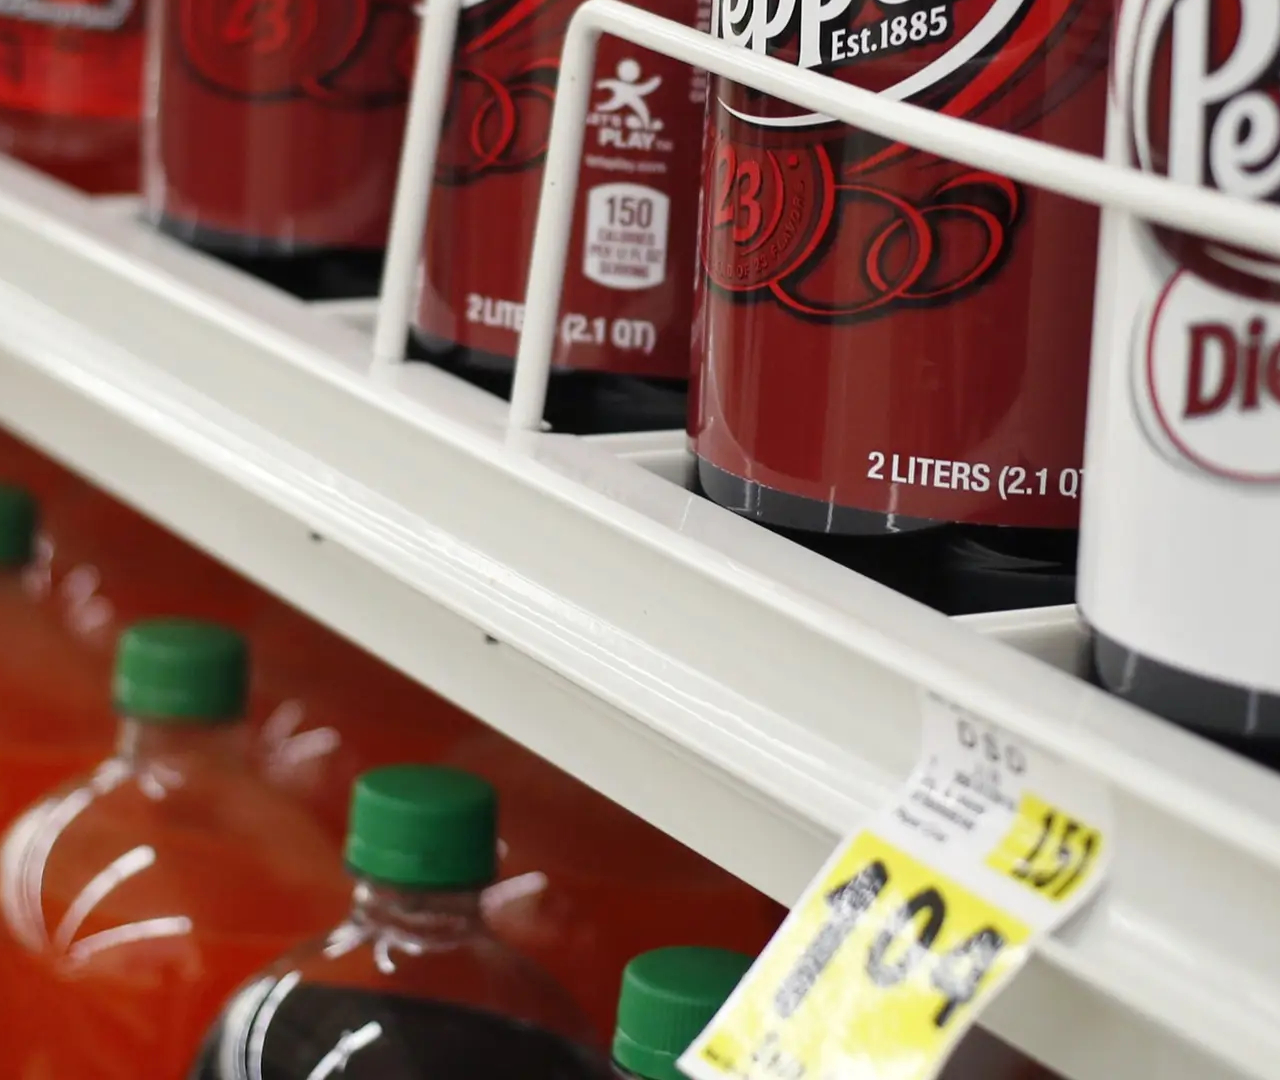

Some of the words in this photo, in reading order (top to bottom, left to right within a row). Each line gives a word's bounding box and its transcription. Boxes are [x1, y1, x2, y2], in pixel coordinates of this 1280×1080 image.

[831, 5, 949, 62] Est.1885
[597, 128, 657, 152] PLAY
[606, 194, 654, 229] 150
[714, 143, 763, 243] 23
[466, 293, 482, 322] 2
[867, 451, 886, 480] 2
[891, 453, 991, 493] LITERS
[998, 465, 1049, 501] (2.1
